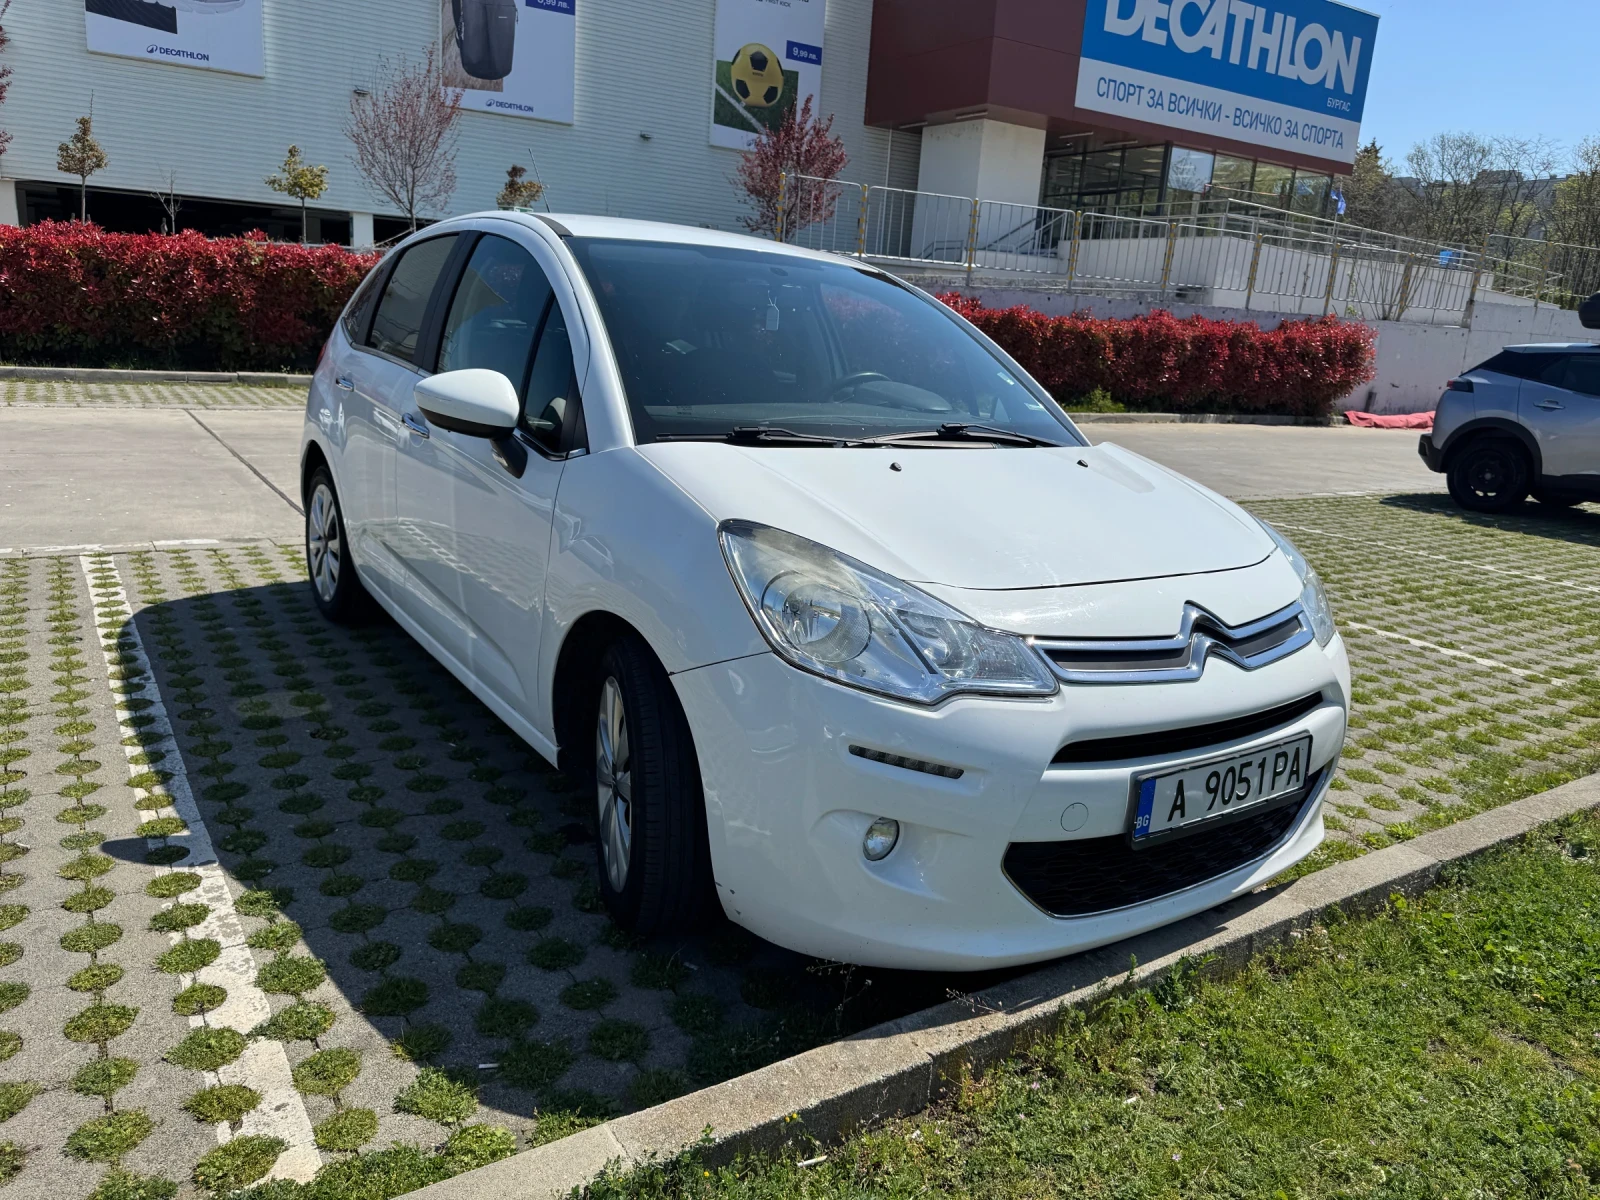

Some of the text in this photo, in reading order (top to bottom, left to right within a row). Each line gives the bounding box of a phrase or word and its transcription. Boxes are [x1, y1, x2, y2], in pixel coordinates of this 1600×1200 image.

[557, 1, 570, 9] лв.
[159, 46, 210, 61] DECATHLON
[792, 46, 808, 58] 9,99
[1103, 0, 1362, 94] DECATHLON
[495, 100, 534, 112] DECATHLON
[1326, 97, 1351, 112] БУРГАС
[1096, 76, 1145, 105] СПОРТ
[1146, 88, 1164, 110] ЗА
[1167, 92, 1222, 123] ВСИЧКИ
[1232, 107, 1282, 135] ВСИЧКО
[1284, 119, 1299, 140] ЗА
[1301, 123, 1344, 149] СПОРТА
[1167, 778, 1186, 822] A
[1136, 814, 1150, 829] BG
